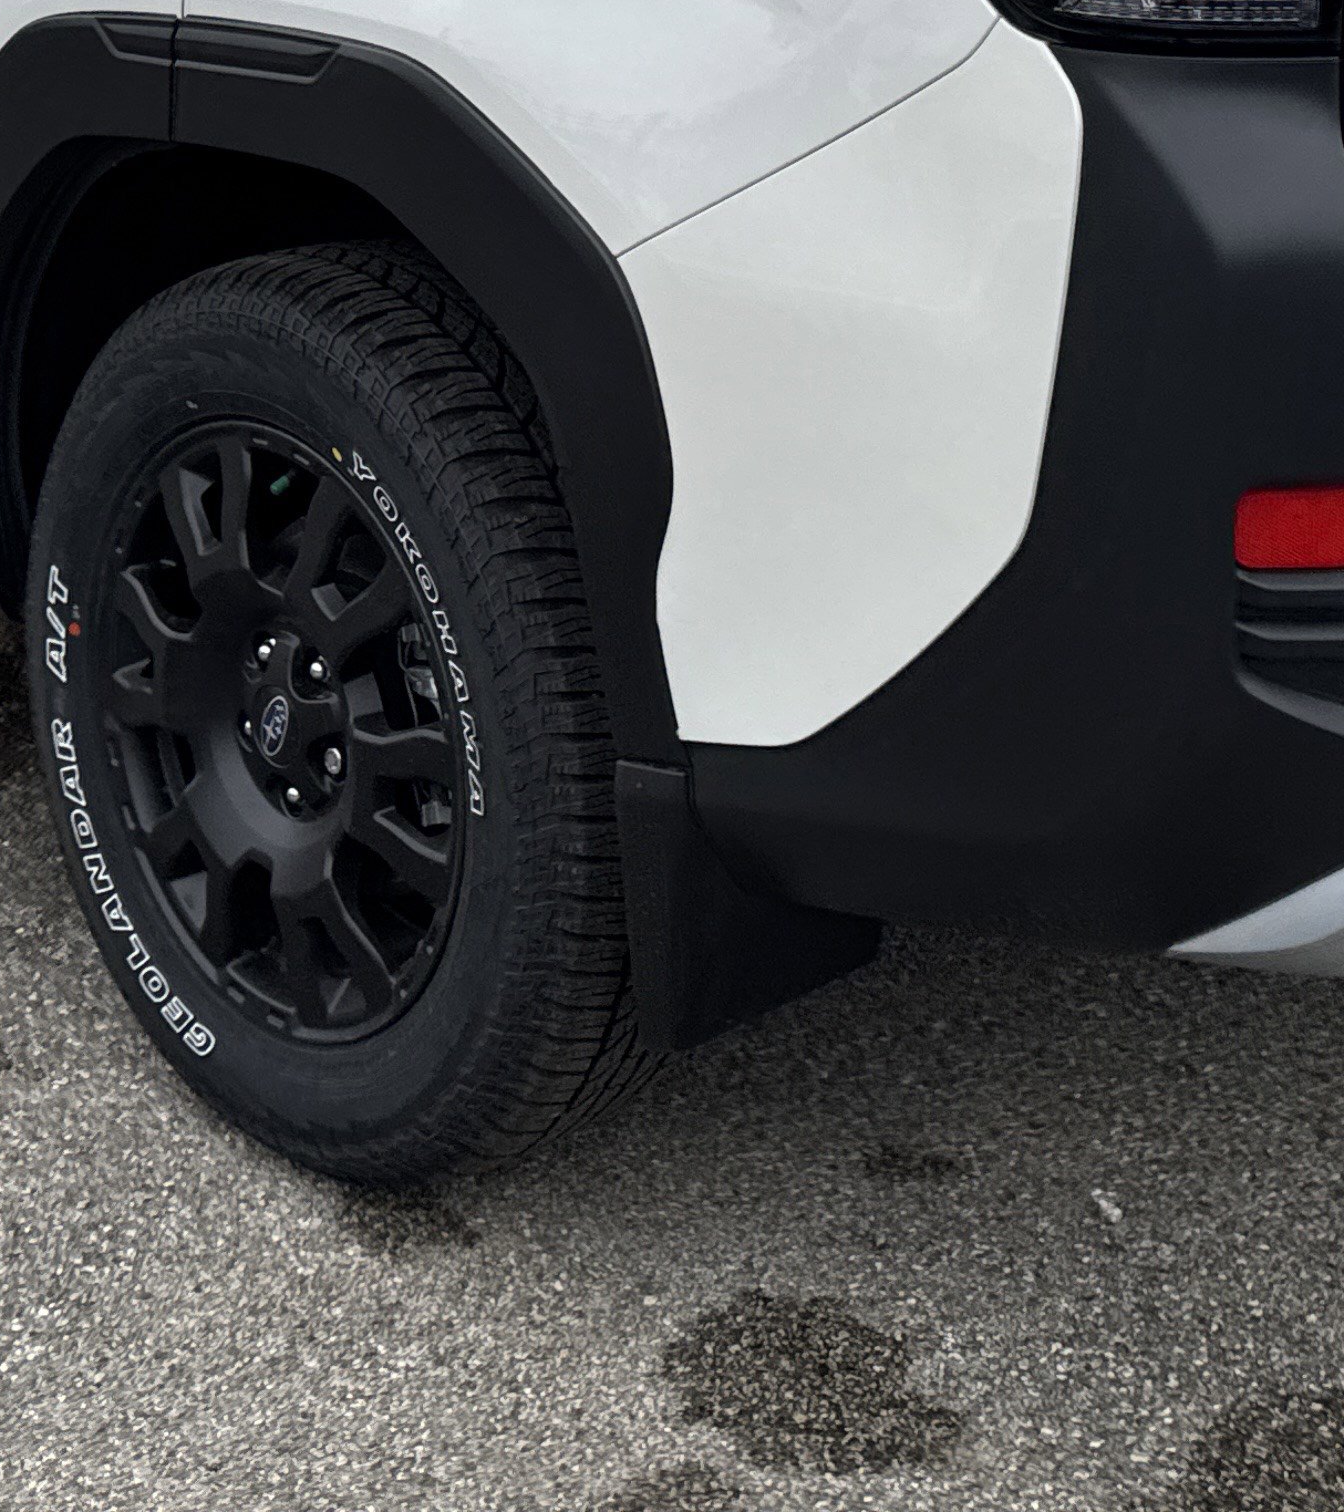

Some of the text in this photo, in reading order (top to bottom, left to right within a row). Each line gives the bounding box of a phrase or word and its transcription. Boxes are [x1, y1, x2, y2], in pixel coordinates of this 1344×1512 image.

[46, 566, 216, 1058] GEOLANDAR A/T
[352, 451, 484, 816] YOKOHAMA
